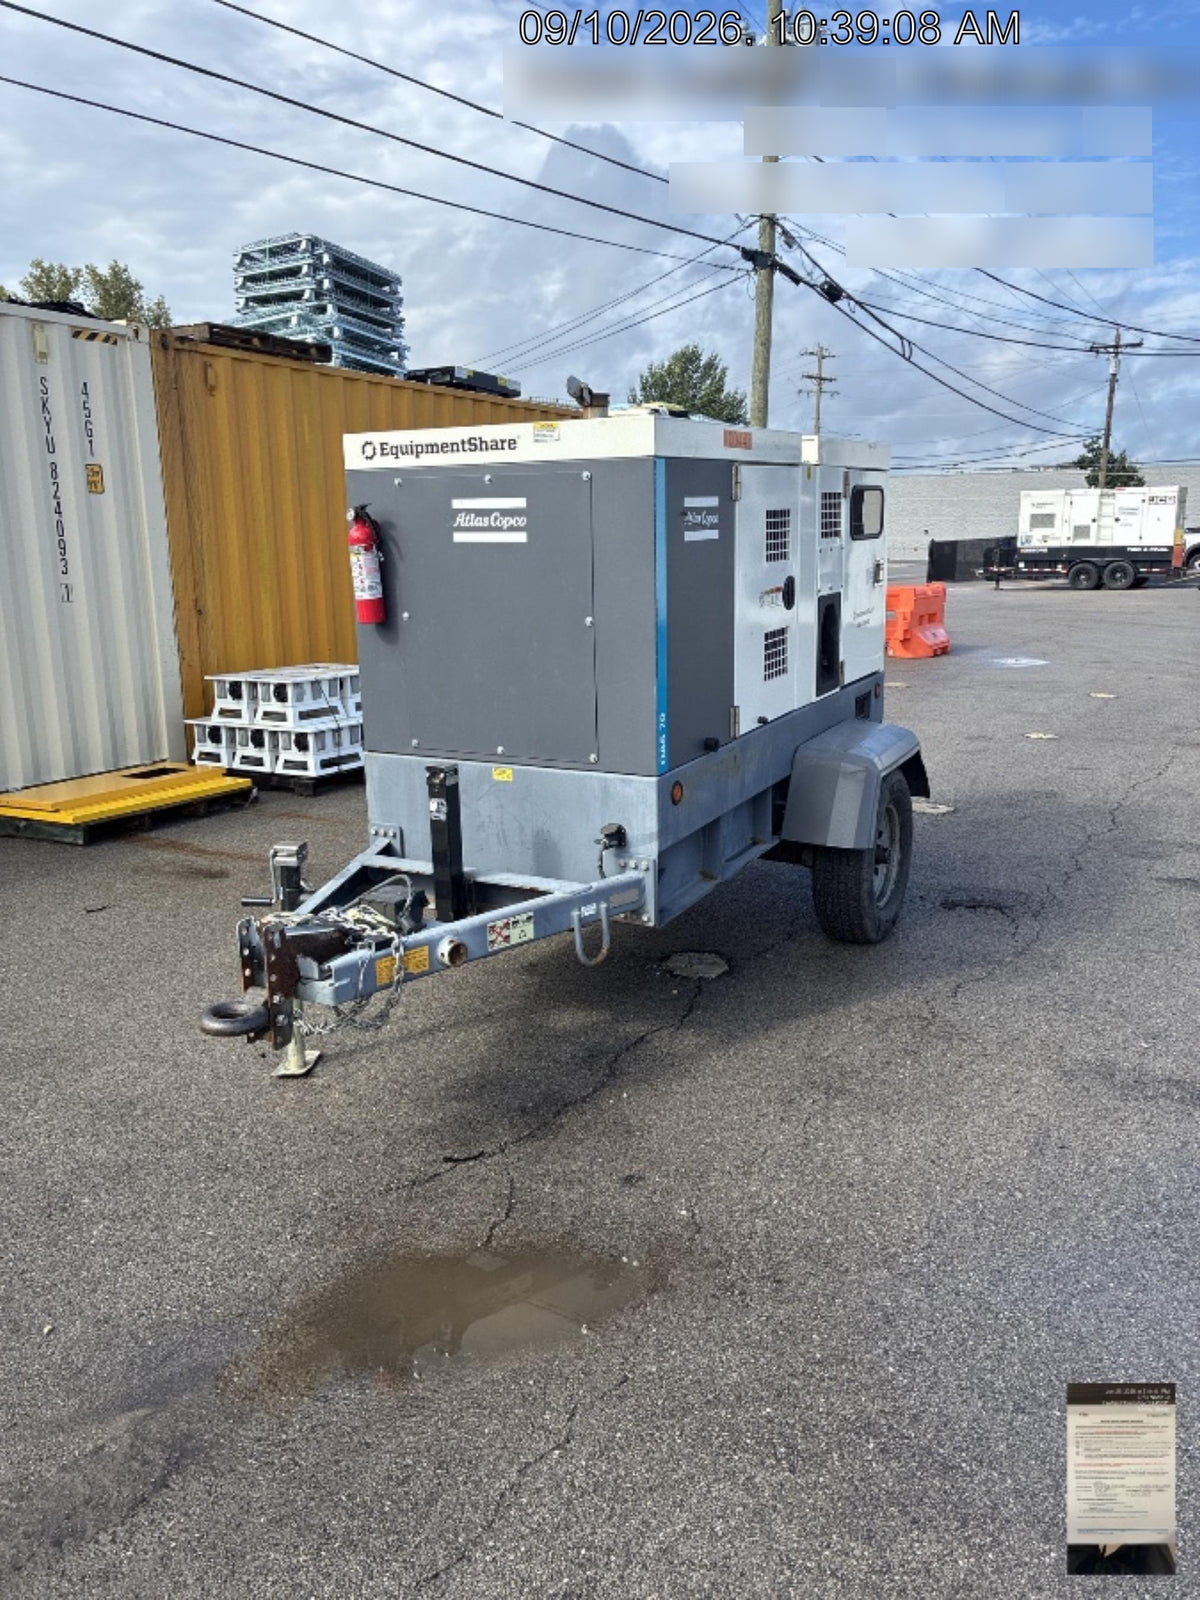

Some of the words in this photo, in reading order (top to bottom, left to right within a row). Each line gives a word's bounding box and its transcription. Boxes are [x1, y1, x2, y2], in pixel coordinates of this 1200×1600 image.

[81, 381, 94, 457] 45G1
[379, 436, 518, 460] EquipmentShare
[40, 376, 55, 454] SKYU
[50, 461, 69, 575] 824093
